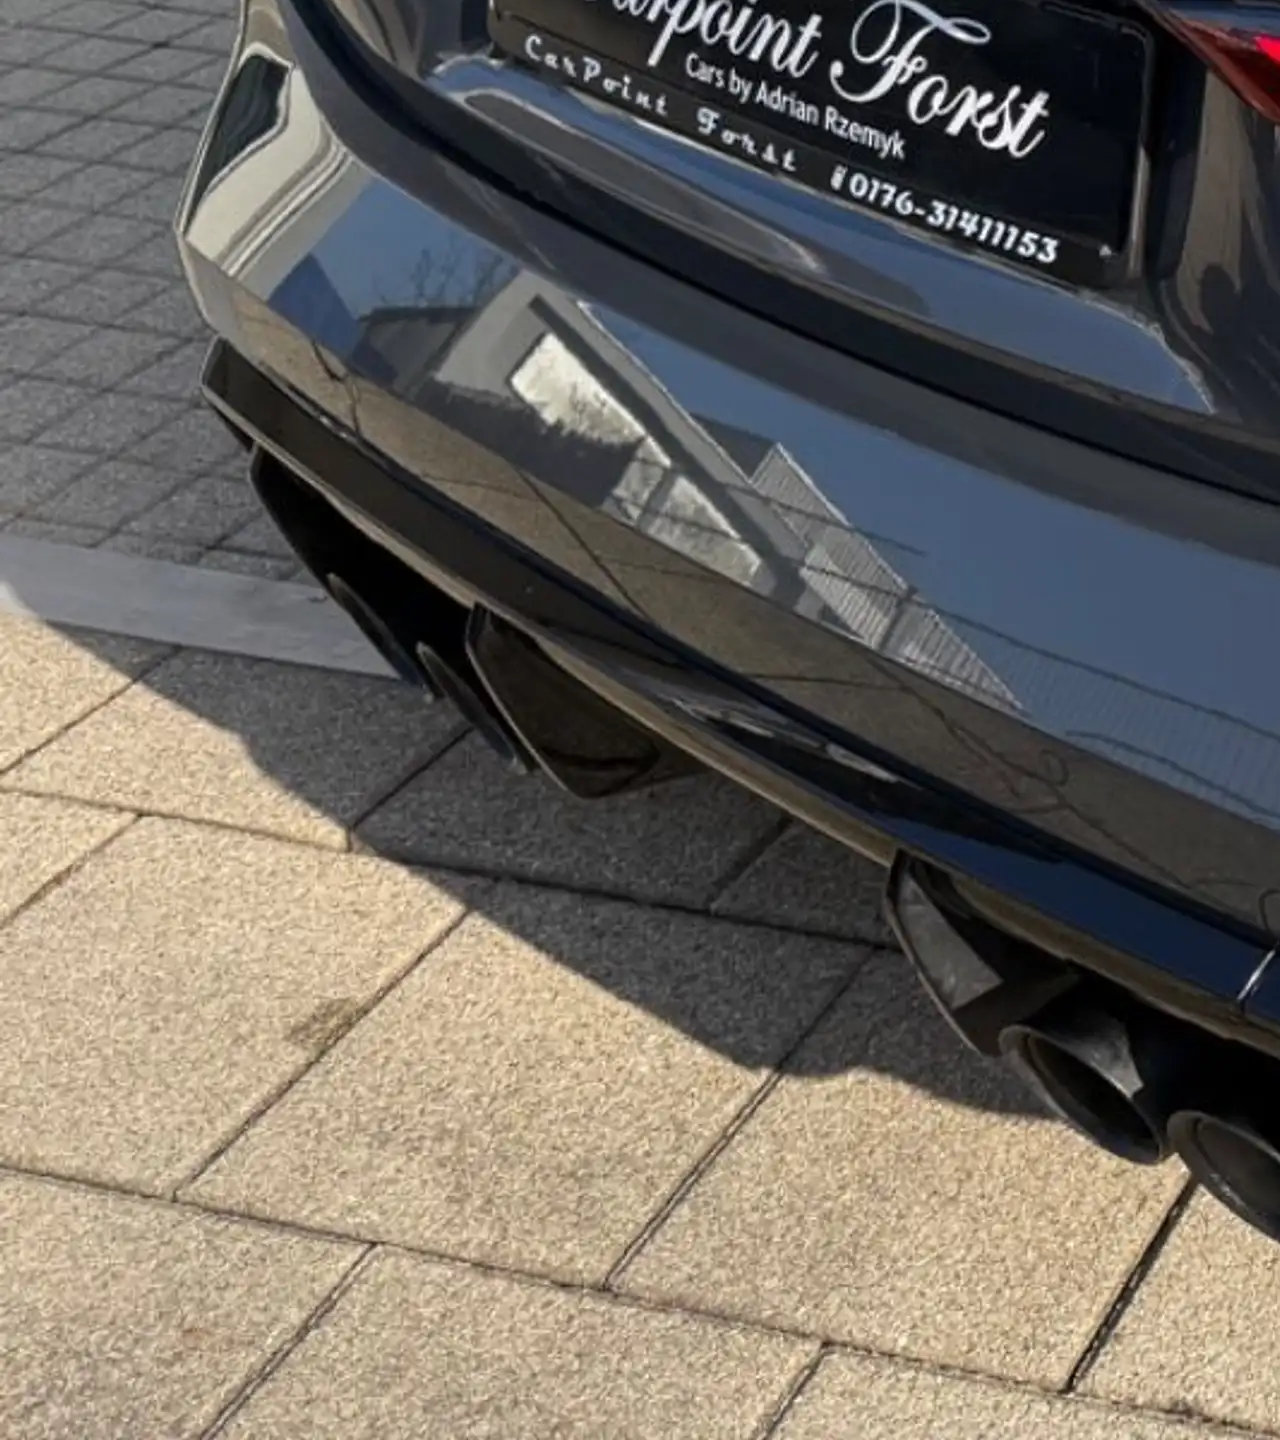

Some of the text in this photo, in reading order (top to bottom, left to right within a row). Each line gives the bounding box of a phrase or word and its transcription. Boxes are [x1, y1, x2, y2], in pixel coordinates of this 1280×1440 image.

[686, 52, 905, 160] Cars by Adrian Rzemyk
[849, 172, 1059, 263] 0176-31411153
